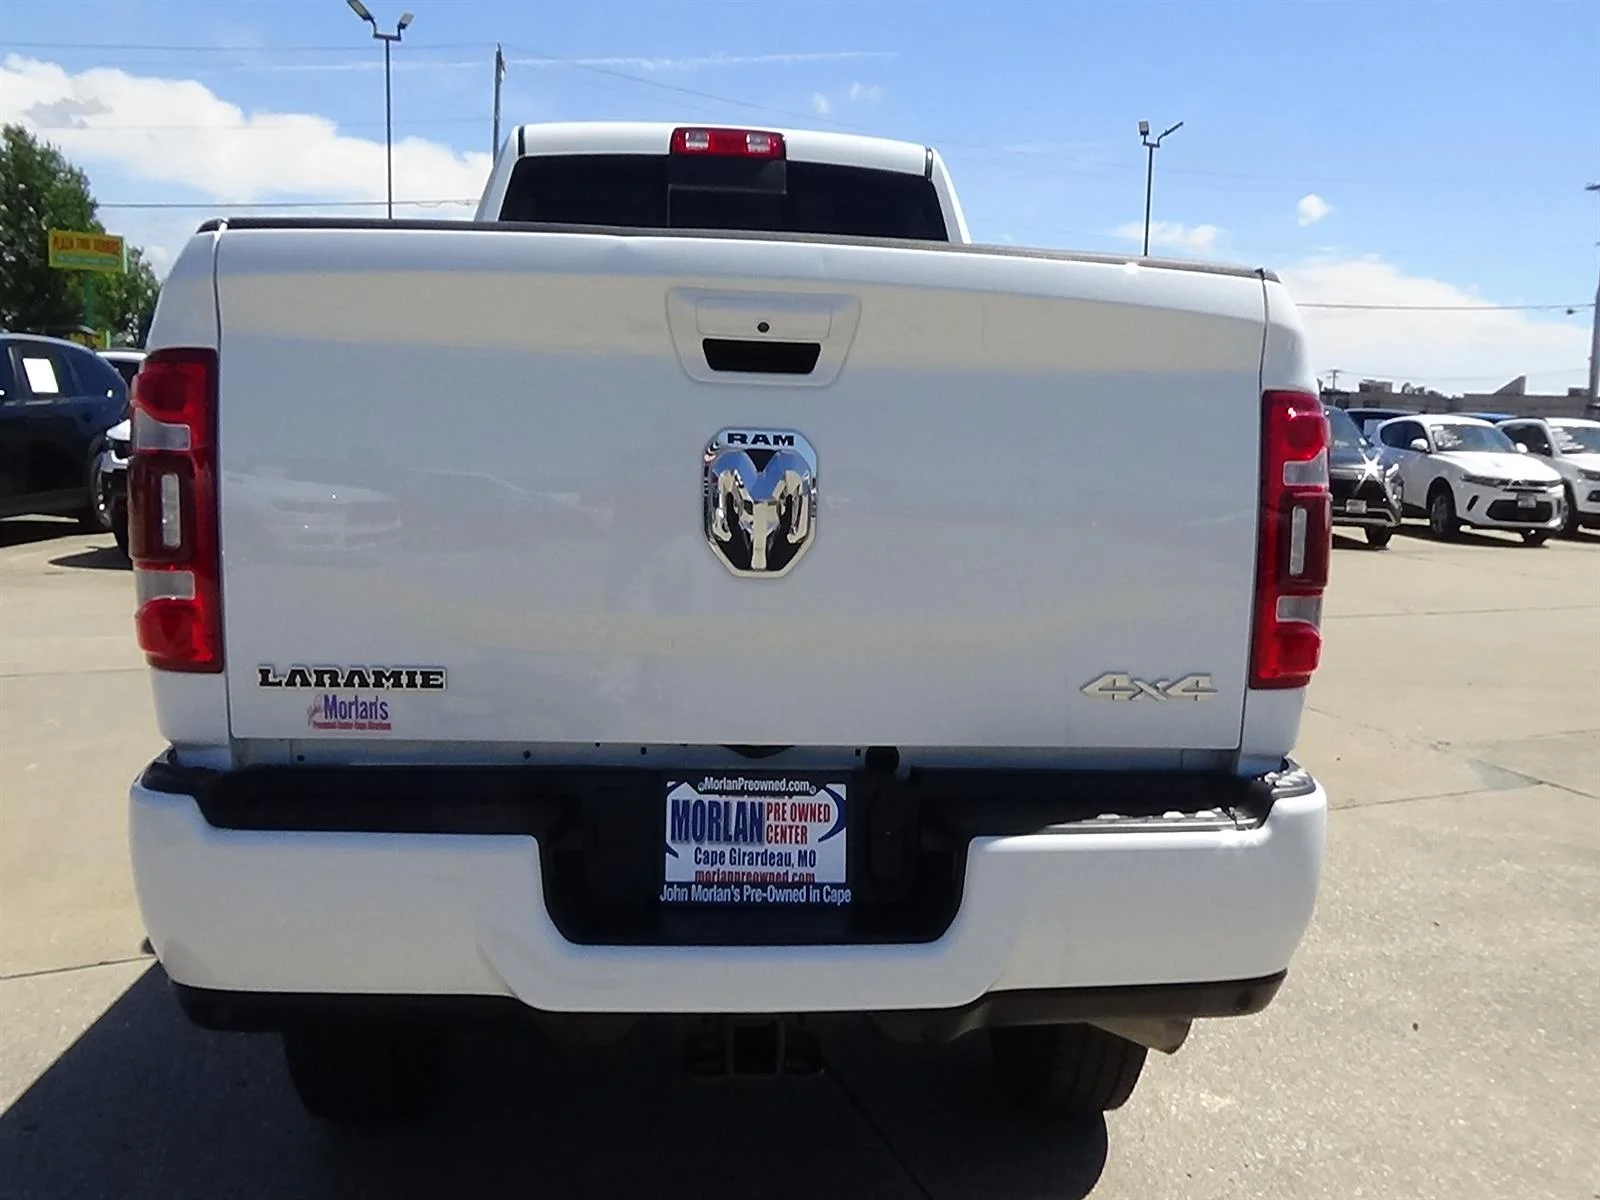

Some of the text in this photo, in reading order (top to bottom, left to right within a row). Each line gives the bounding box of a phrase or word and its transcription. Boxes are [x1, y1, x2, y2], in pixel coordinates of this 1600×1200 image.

[727, 433, 795, 446] RAM
[258, 667, 446, 690] LARAMIE
[323, 694, 389, 720] Morlan's
[704, 776, 810, 791] MorlanPreowned.com
[671, 799, 764, 844] MORLAN
[766, 802, 831, 823] PRE OWNED
[766, 824, 808, 845] CENTER
[694, 847, 816, 868] Cape Girardeau, MO
[660, 885, 851, 905] John Morlan's Pre-Owned in Cape
